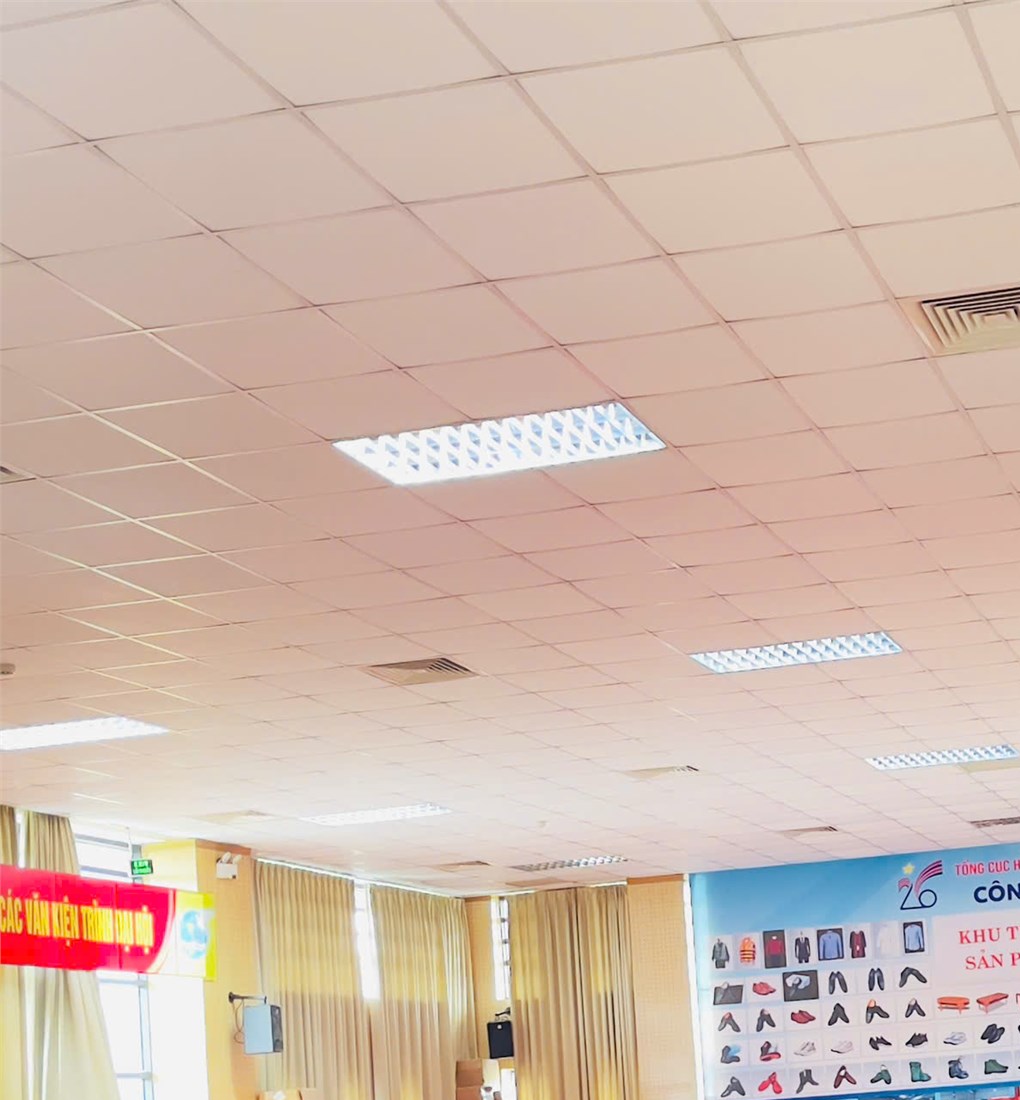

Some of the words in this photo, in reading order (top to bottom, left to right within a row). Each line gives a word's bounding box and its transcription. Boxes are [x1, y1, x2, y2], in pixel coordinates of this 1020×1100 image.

[25, 891, 50, 937] VĂN
[51, 895, 80, 947] KIỆN
[958, 927, 1001, 945] KHU
[965, 950, 1003, 970] SẢN
